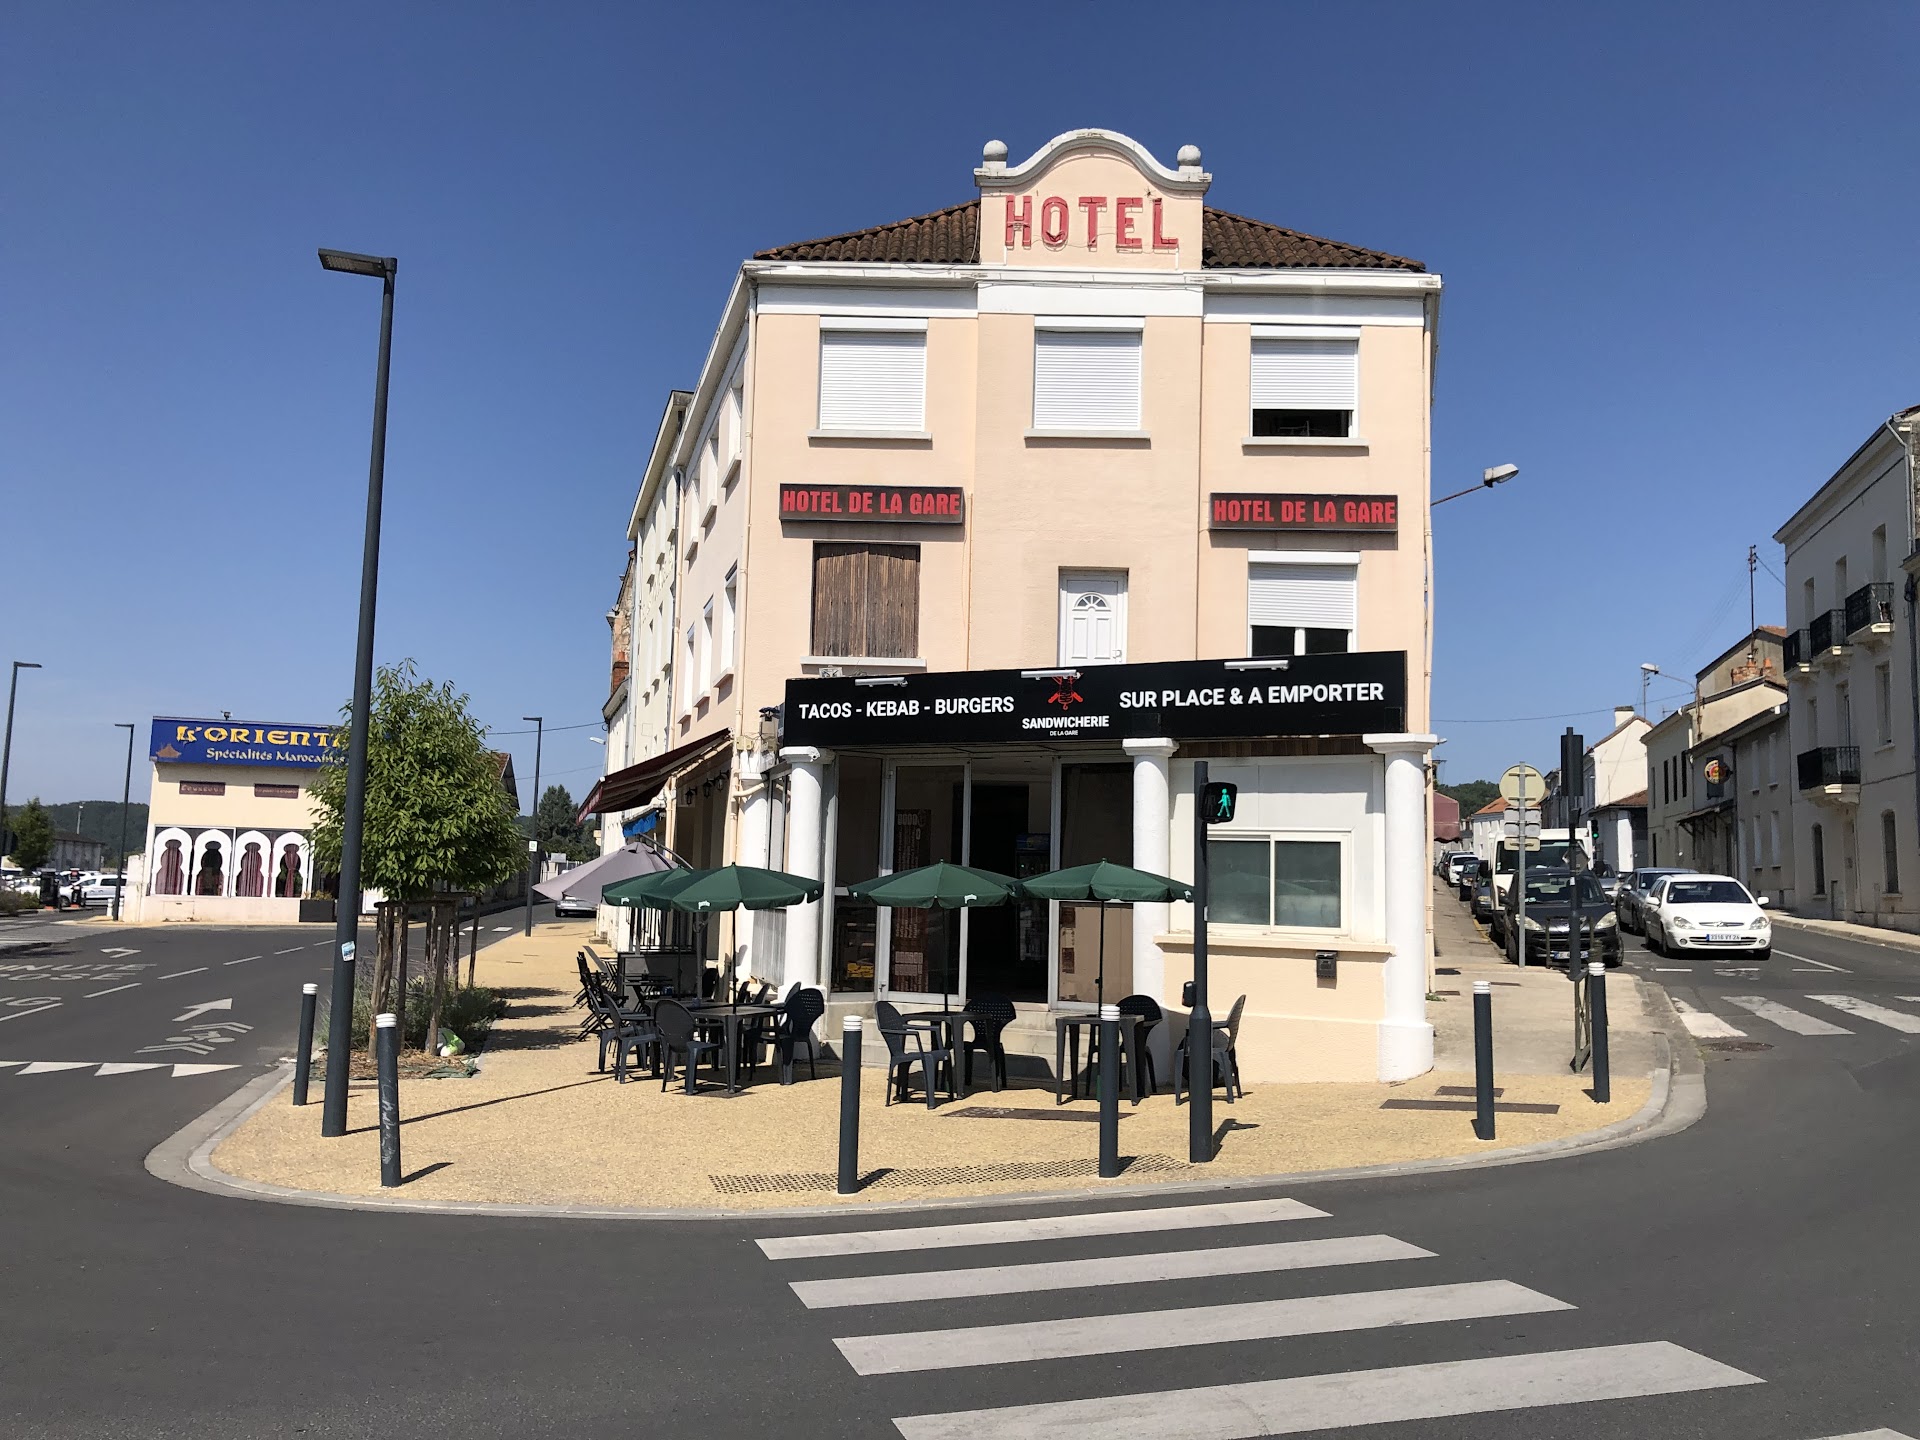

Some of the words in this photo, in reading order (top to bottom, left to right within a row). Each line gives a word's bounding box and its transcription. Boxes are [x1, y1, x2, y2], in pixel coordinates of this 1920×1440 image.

[1005, 195, 1179, 250] HOTEL
[783, 490, 842, 513] HOTEL
[849, 492, 873, 513] DE
[880, 492, 902, 514] LA
[909, 493, 960, 515] GARE
[1214, 500, 1274, 522] HOTEL
[1281, 501, 1306, 522] DE
[1313, 501, 1336, 523] LA
[1344, 502, 1395, 523] GARE
[1119, 690, 1157, 708] SUR
[1162, 688, 1225, 707] PLACE
[1229, 687, 1243, 705] &
[1248, 687, 1263, 704] A
[1268, 682, 1384, 703] EMPORTER
[799, 702, 852, 719] TACOS
[866, 700, 919, 717] KEBAB
[935, 696, 1014, 715] BURGERS
[1022, 715, 1110, 729] SANDWICHERIE
[206, 747, 273, 761] Spécialités
